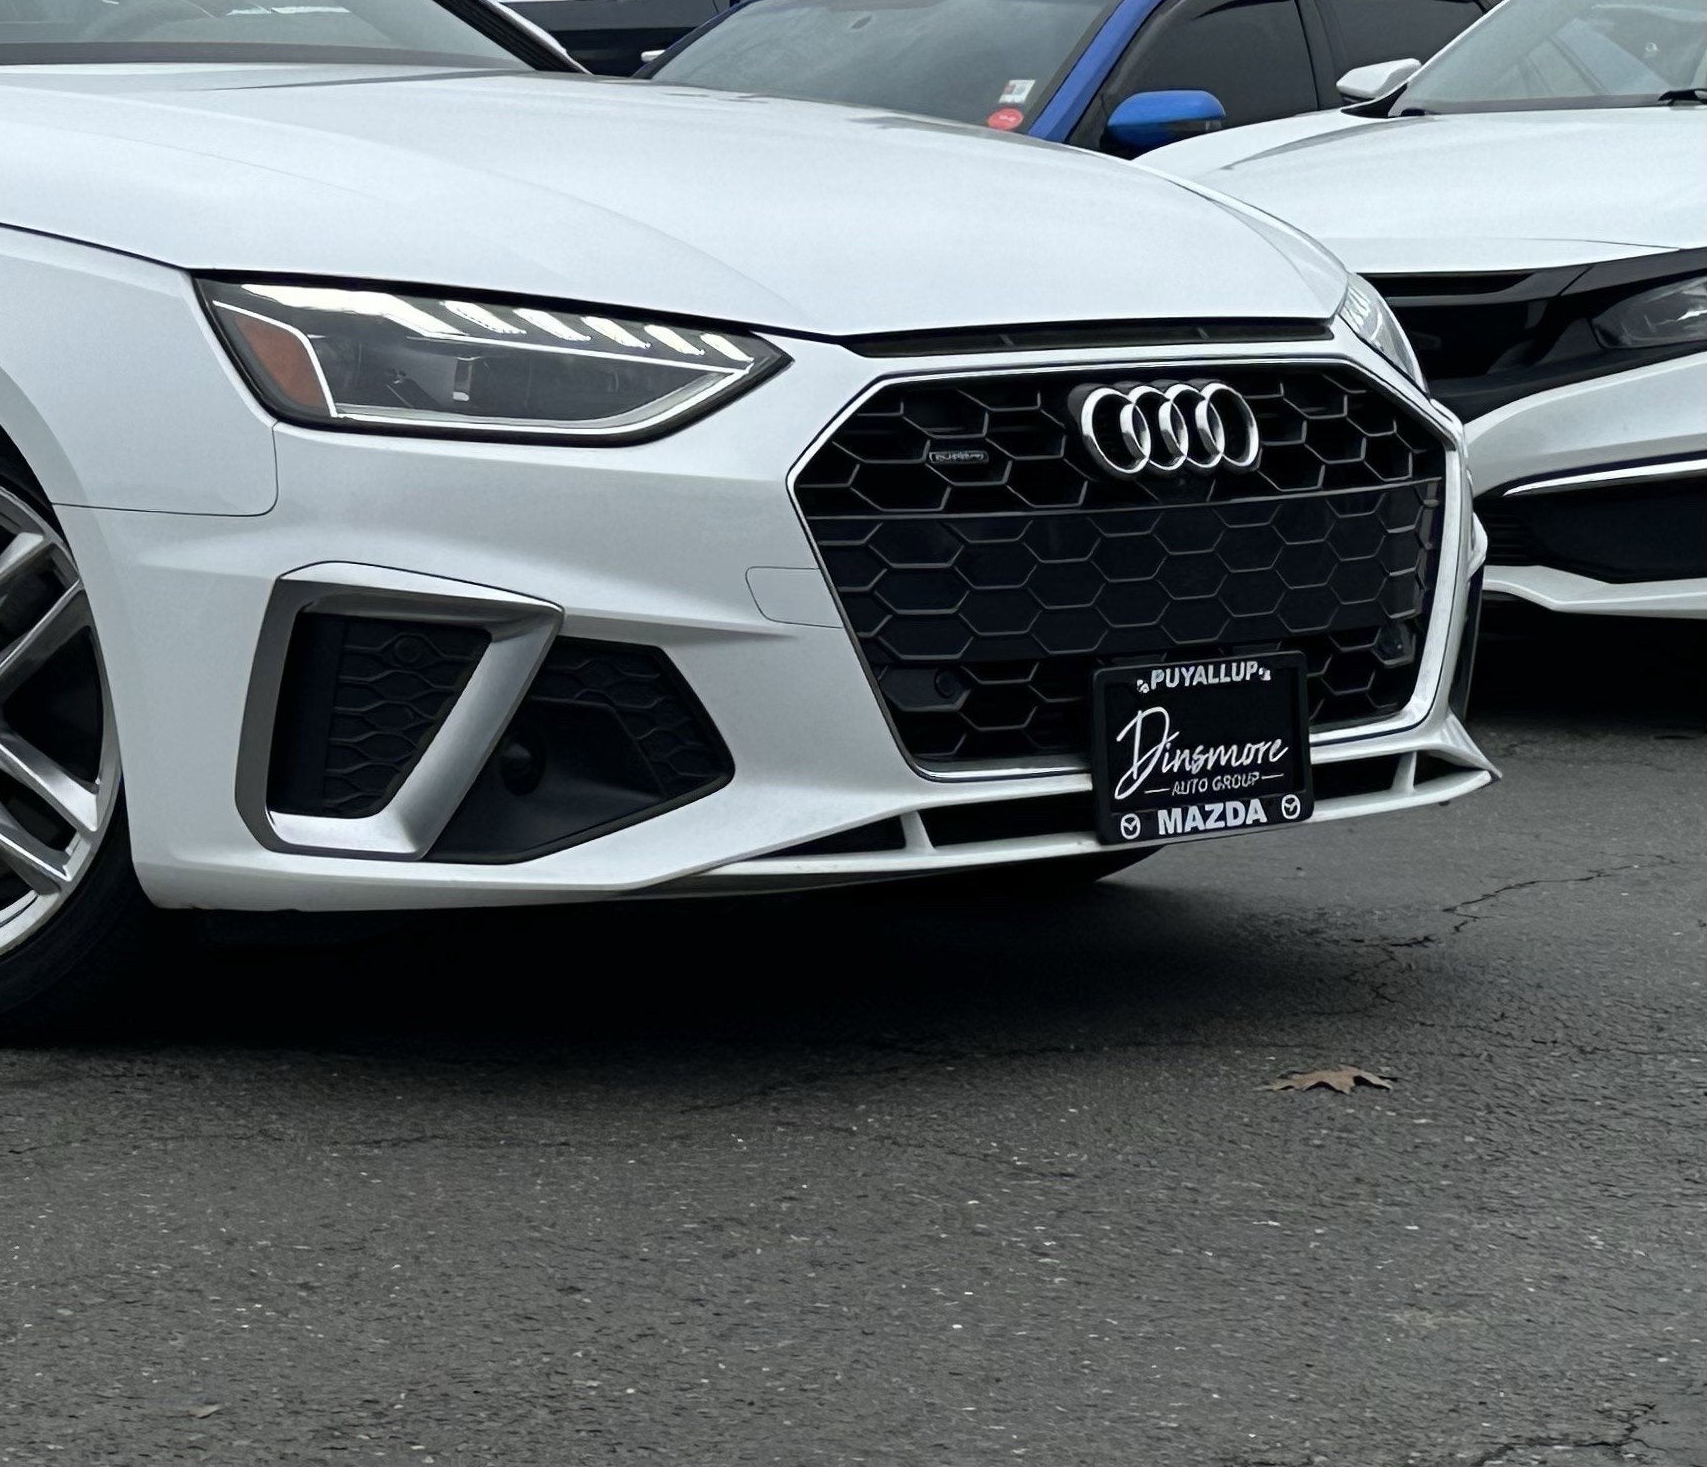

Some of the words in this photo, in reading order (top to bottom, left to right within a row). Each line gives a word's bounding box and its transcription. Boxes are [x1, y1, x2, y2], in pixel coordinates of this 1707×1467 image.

[1150, 661, 1258, 690] PUYALLUP
[1114, 706, 1289, 800] Dinsmore
[1171, 777, 1208, 796] AUTO
[1212, 771, 1260, 790] GROUP
[1157, 798, 1268, 835] MAZDA
